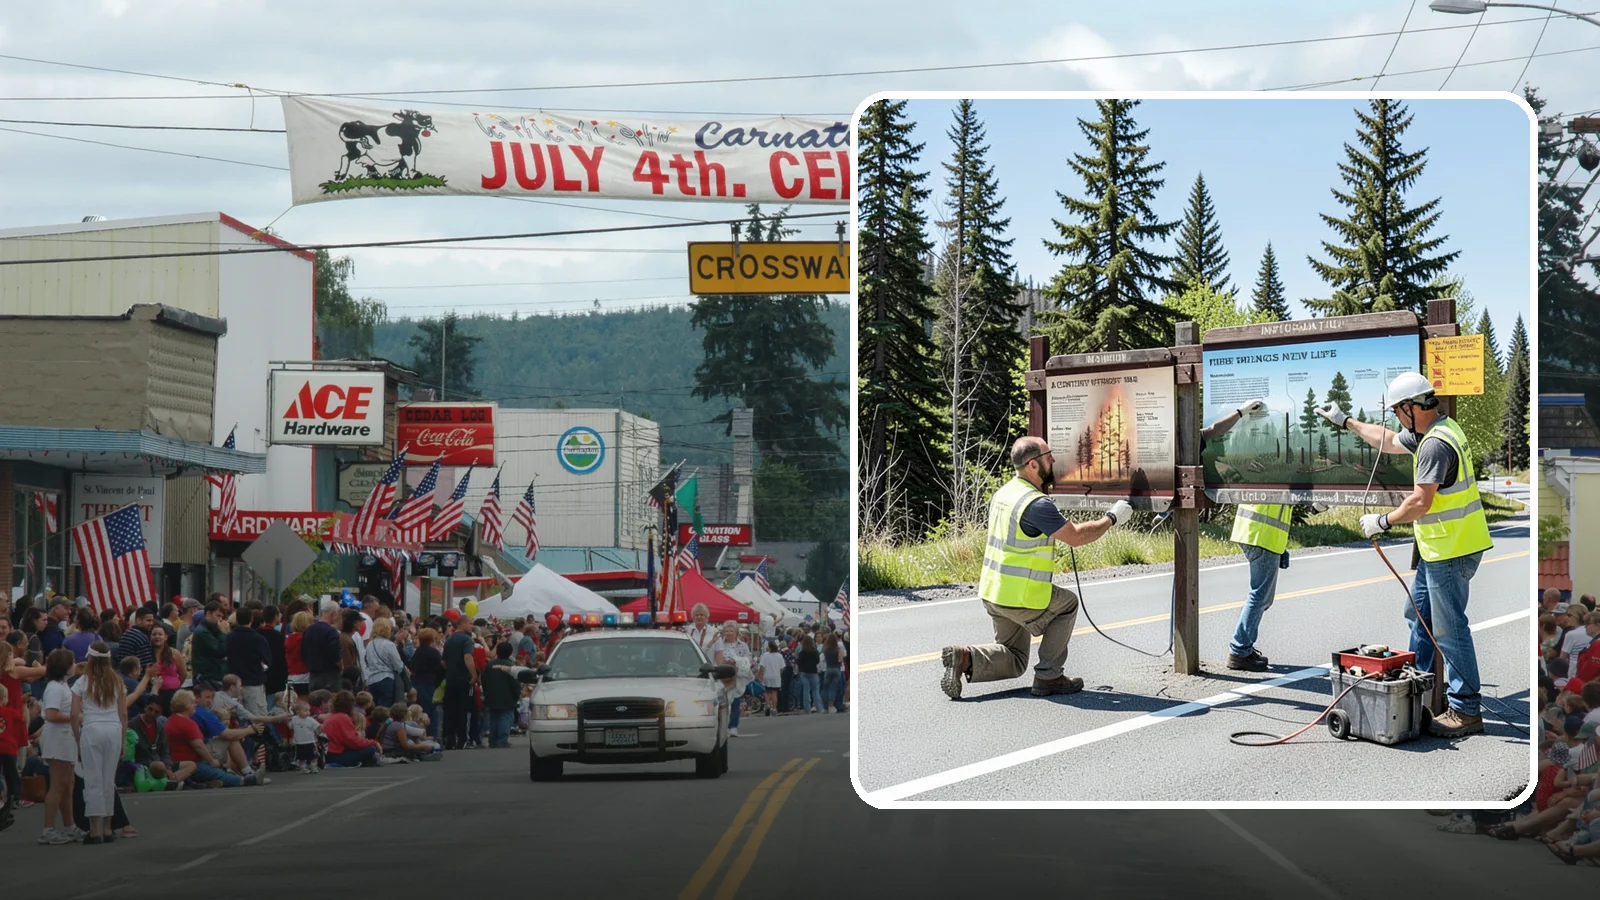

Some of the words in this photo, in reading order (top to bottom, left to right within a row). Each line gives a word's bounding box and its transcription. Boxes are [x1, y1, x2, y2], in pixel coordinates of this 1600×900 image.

[481, 141, 605, 192] JULY
[632, 150, 746, 197] 4th.
[697, 254, 850, 280] CROSSWA
[282, 380, 374, 420] ACE
[406, 409, 452, 422] CEDAR
[461, 409, 485, 422] LOG
[283, 421, 371, 437] Hardware
[416, 428, 477, 447] Coca-Cola
[95, 485, 124, 495] Vincent
[126, 485, 136, 495] de
[137, 486, 155, 496] Paul
[699, 535, 730, 543] GLASS
